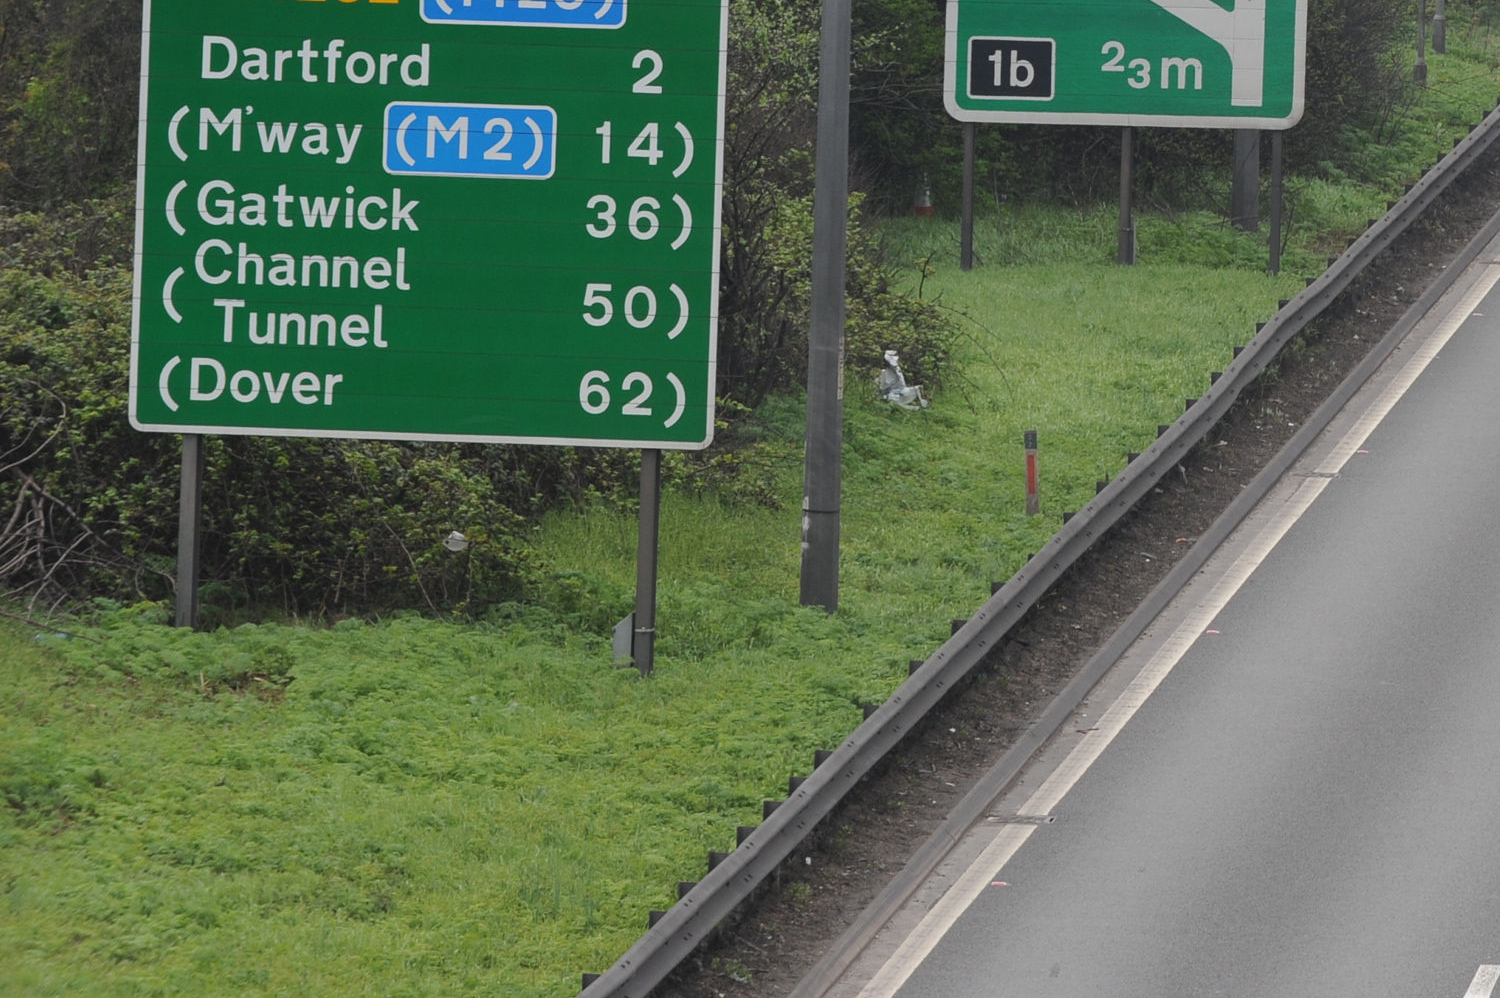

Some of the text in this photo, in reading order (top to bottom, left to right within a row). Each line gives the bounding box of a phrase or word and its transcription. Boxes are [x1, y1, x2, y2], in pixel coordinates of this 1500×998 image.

[201, 35, 664, 94] Dartford 2
[988, 48, 1035, 89] 1b
[194, 238, 411, 291] Channel
[213, 297, 388, 349] Tunnel
